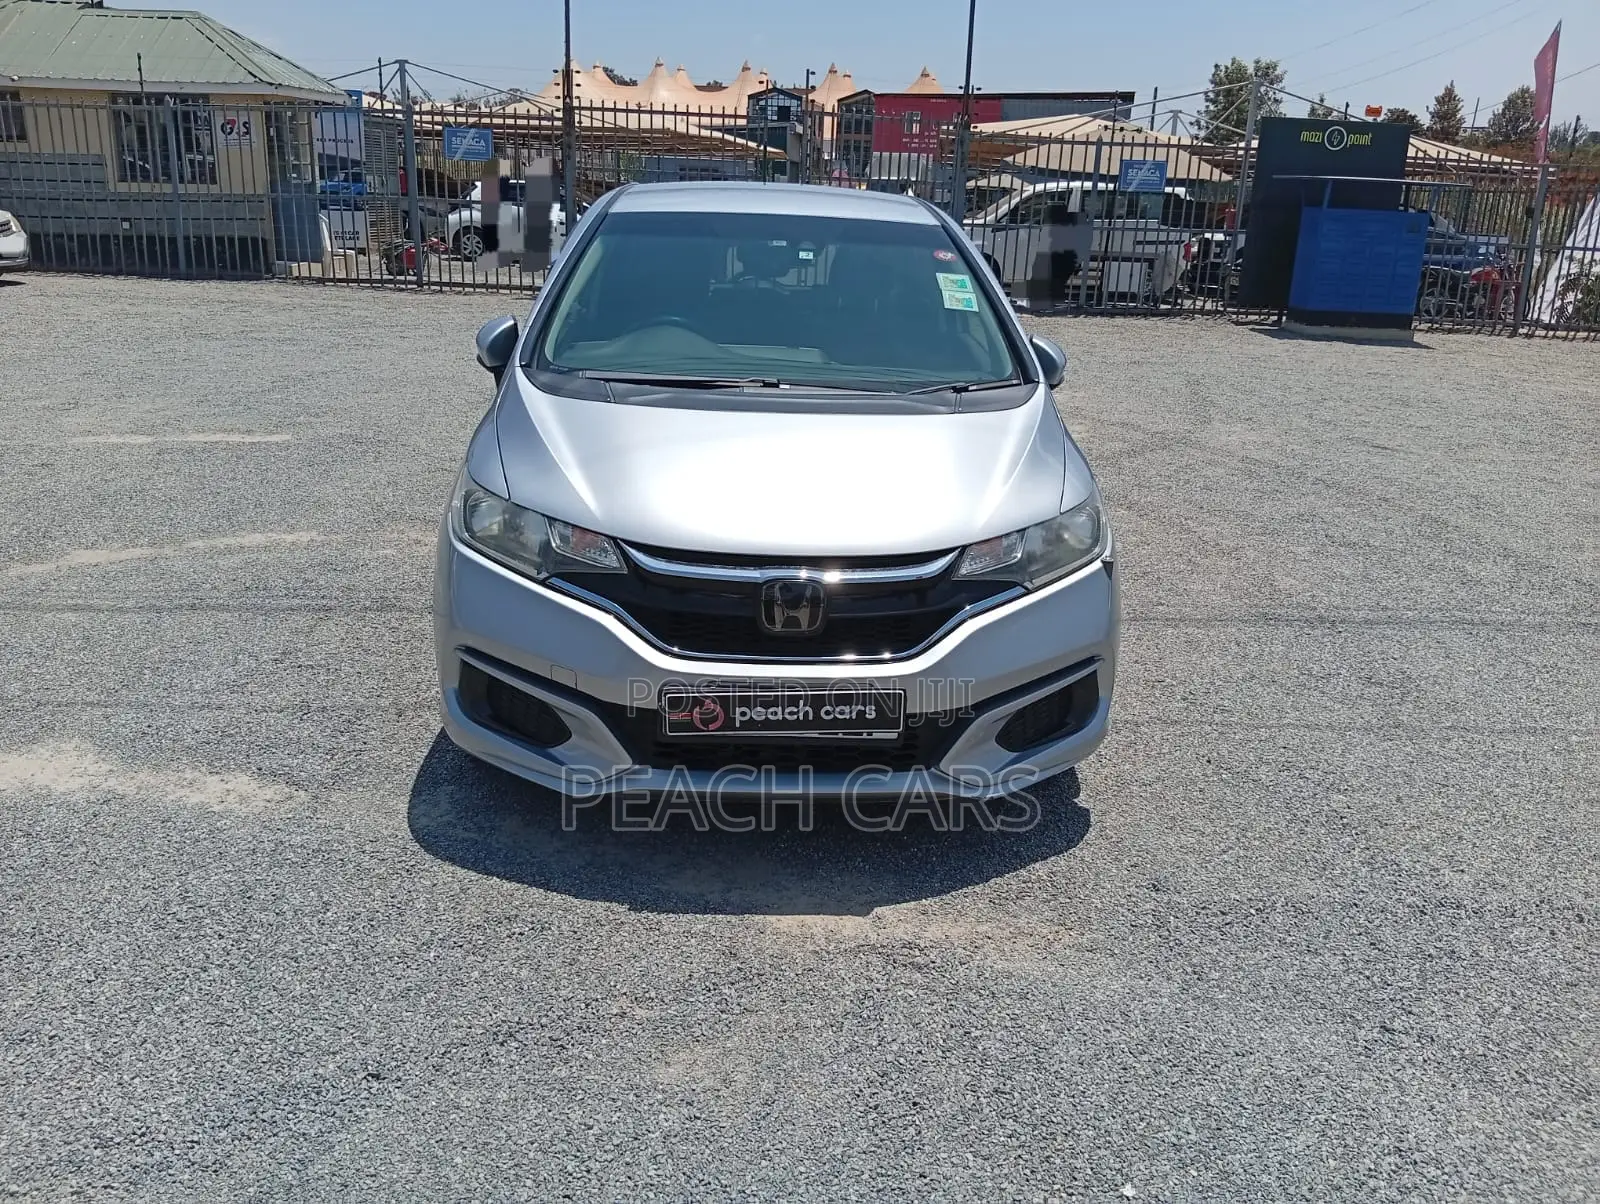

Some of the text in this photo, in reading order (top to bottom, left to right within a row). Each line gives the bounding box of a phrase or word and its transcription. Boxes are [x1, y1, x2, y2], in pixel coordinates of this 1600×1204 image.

[1300, 131, 1372, 148] mazi point
[736, 700, 877, 727] peach cars
